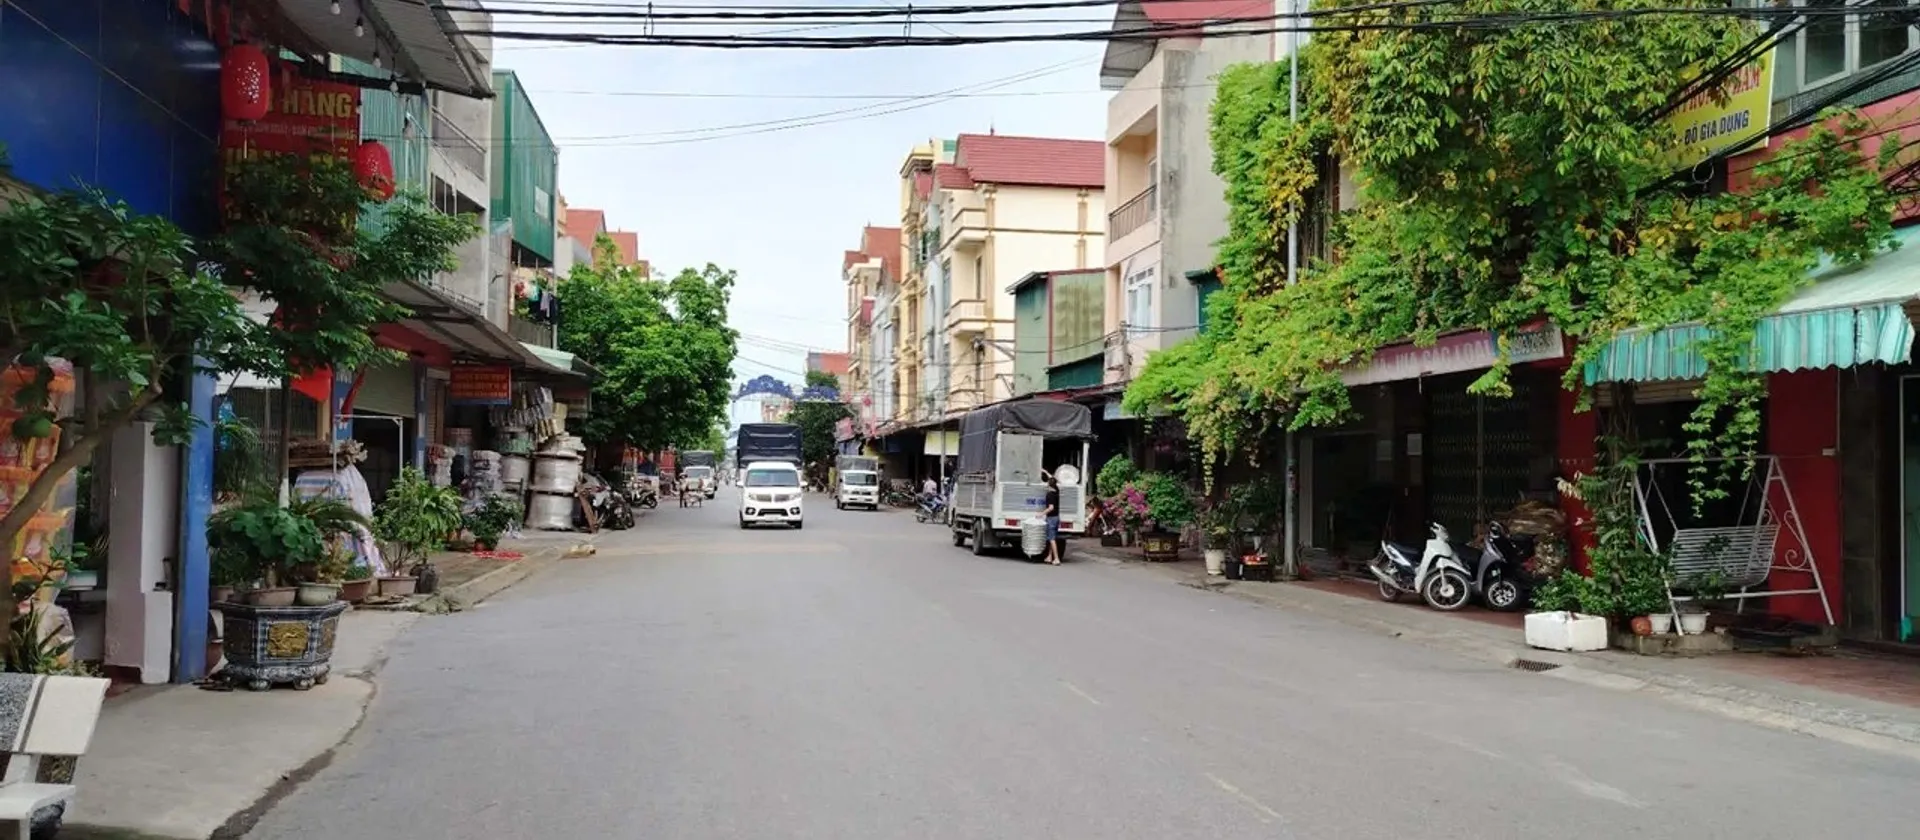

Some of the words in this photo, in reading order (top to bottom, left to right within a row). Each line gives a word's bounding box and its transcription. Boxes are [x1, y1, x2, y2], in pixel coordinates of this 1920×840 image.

[1684, 120, 1698, 145] ĐỒ
[1700, 120, 1717, 140] GIA
[1719, 109, 1749, 136] DỤNG
